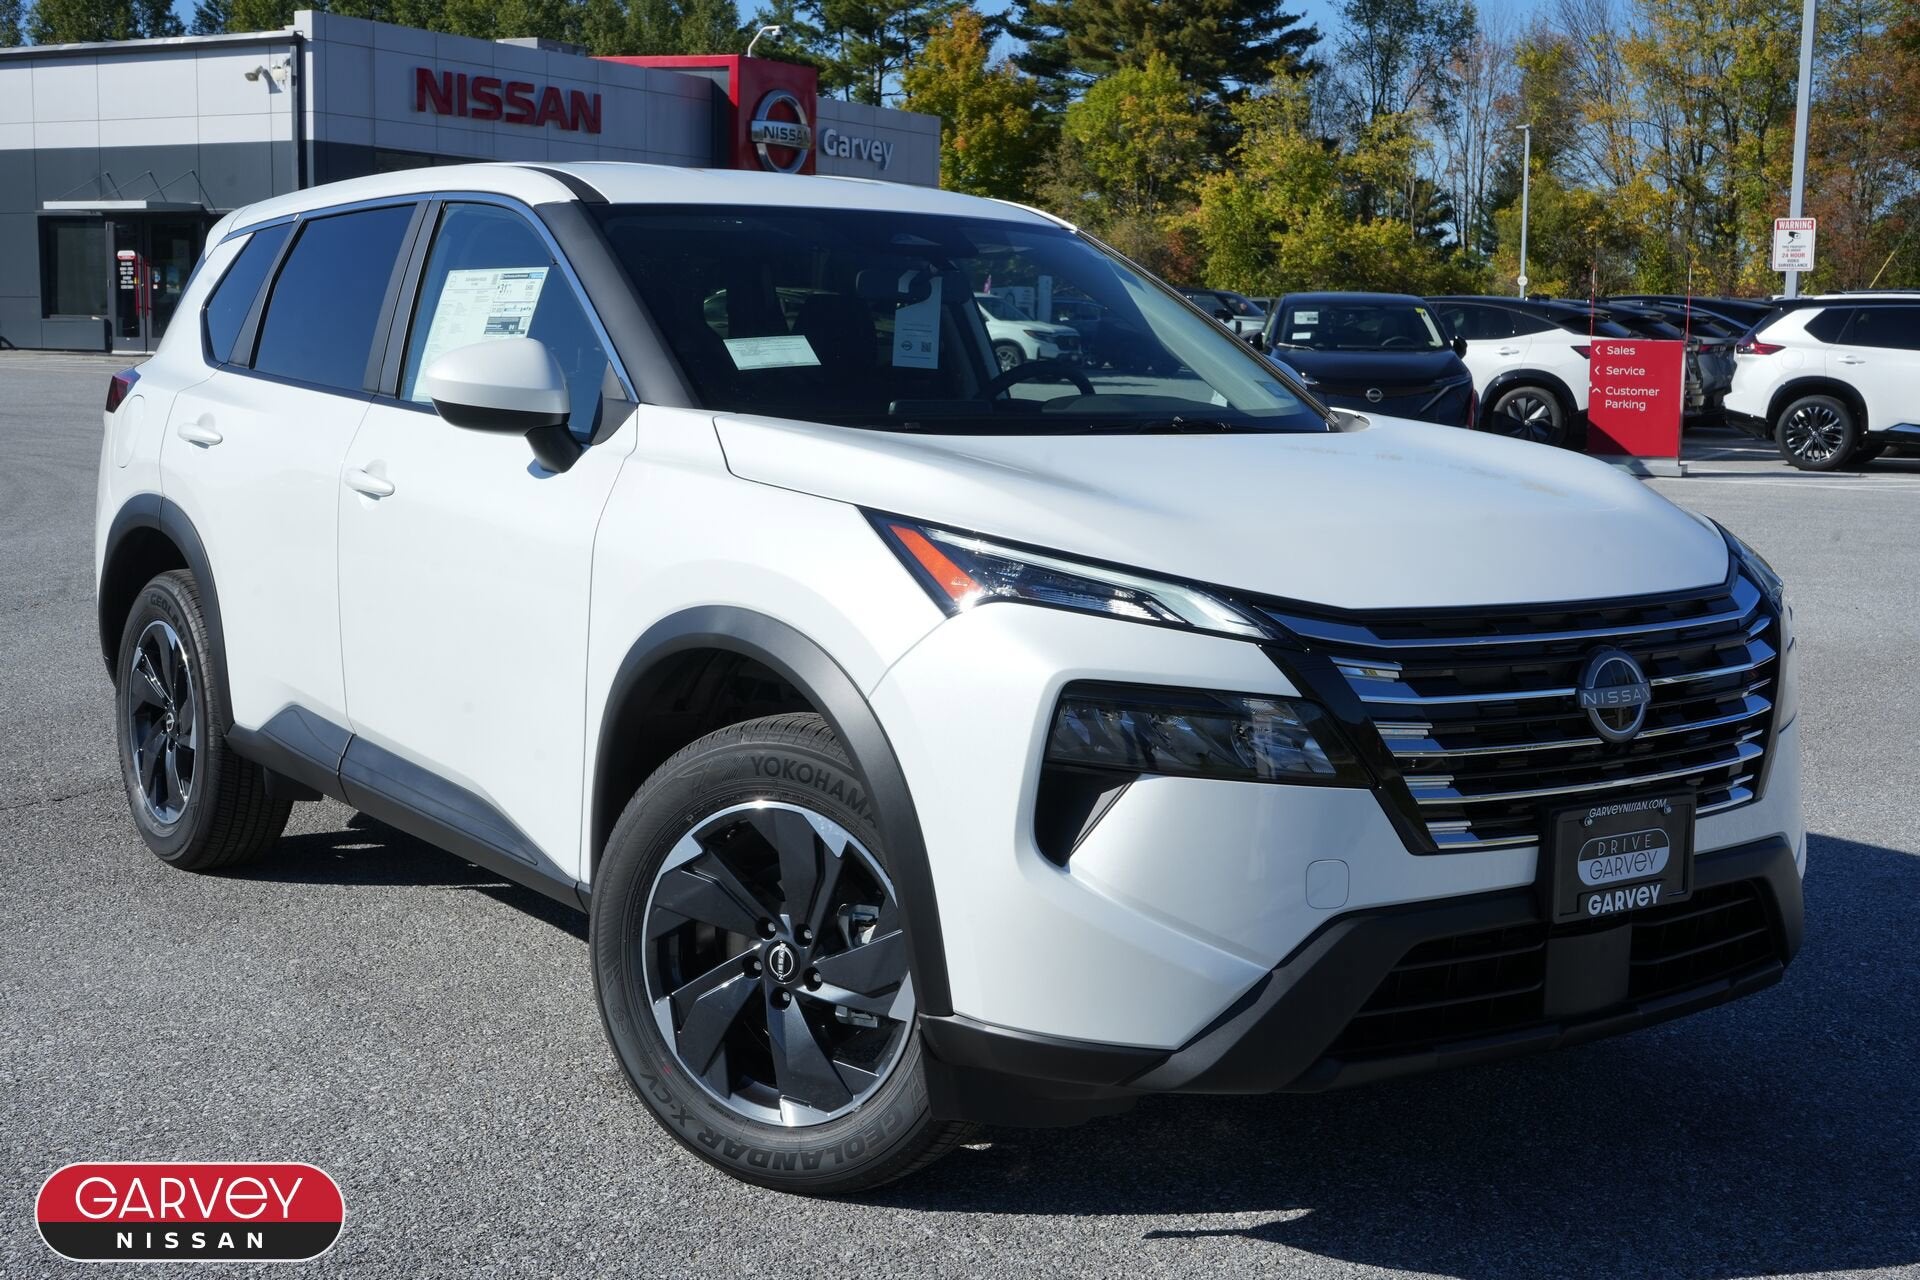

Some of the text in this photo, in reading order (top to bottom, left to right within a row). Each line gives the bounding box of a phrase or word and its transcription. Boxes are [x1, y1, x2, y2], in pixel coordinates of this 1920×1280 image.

[415, 67, 602, 134] NISSAN
[763, 125, 809, 142] NISSAN
[823, 128, 894, 170] Garvey
[1779, 220, 1812, 229] WARNING
[1607, 345, 1636, 355] Sales
[1606, 366, 1645, 376] Service
[1605, 387, 1660, 396] Customer
[1605, 399, 1646, 411] Parking
[1583, 687, 1651, 705] NISSAN
[1598, 833, 1652, 856] DRIVE
[641, 1072, 697, 1128] X-CV
[697, 1104, 906, 1171] GEOLANDAR
